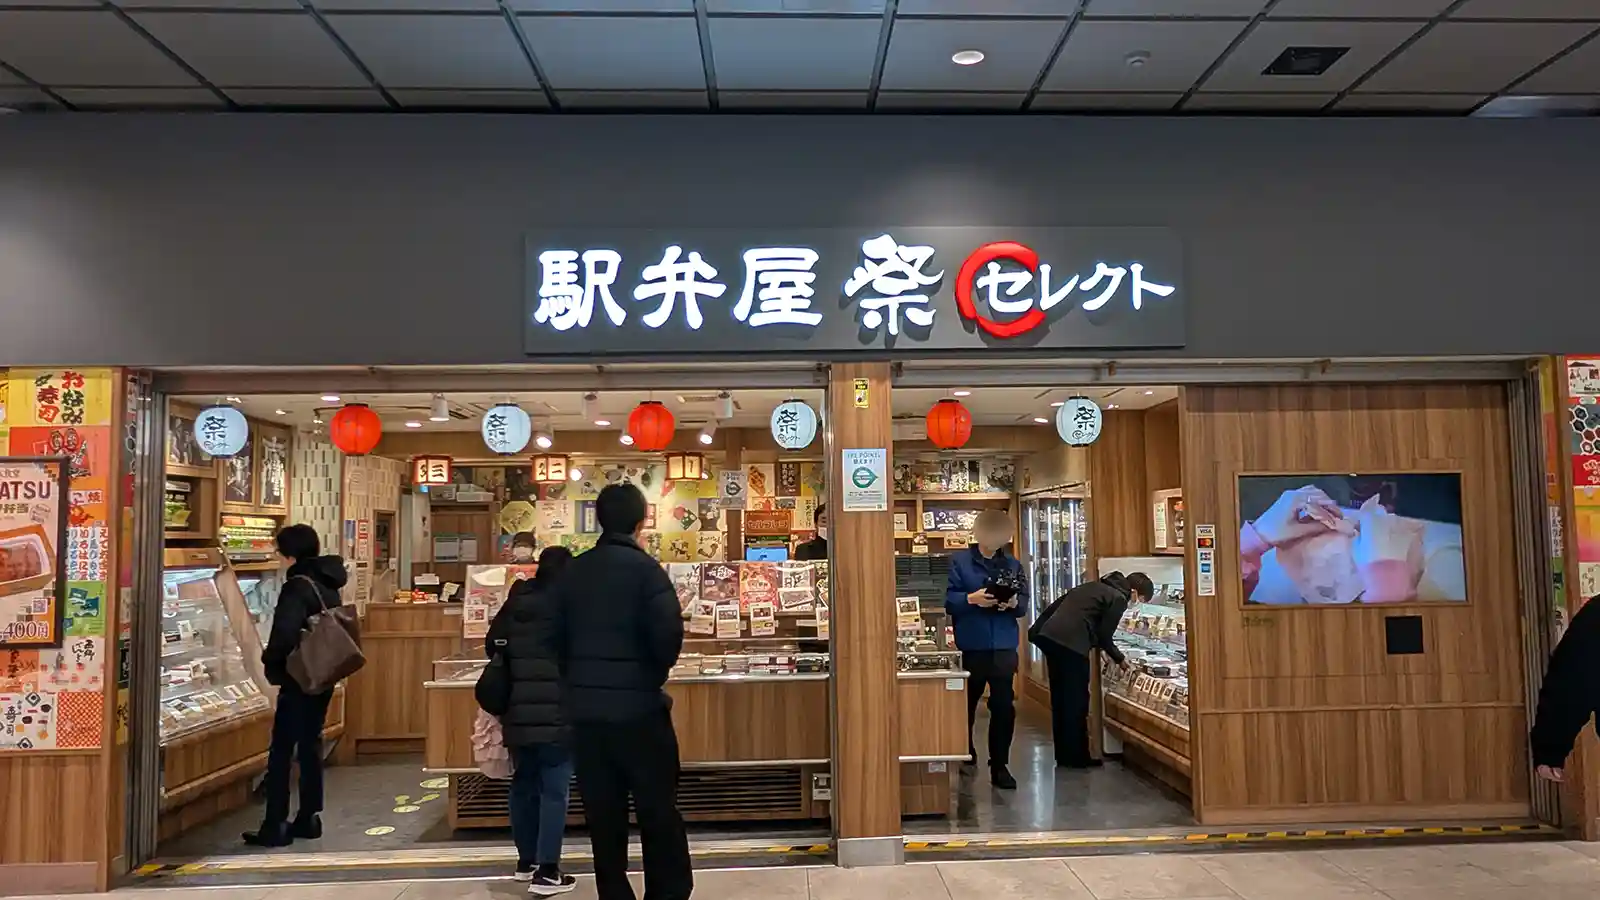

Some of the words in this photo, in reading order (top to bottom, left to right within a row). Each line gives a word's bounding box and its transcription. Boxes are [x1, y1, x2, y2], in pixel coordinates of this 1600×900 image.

[534, 246, 824, 331] 駅弁屋
[846, 234, 944, 335] 祭
[976, 262, 1176, 314] セレクト
[201, 416, 229, 440] 祭
[486, 413, 508, 438] 祭
[777, 409, 799, 434] 祭
[1073, 406, 1096, 430] 祭
[432, 464, 444, 478] 三
[552, 462, 562, 474] 二
[0, 481, 51, 500] ATSU
